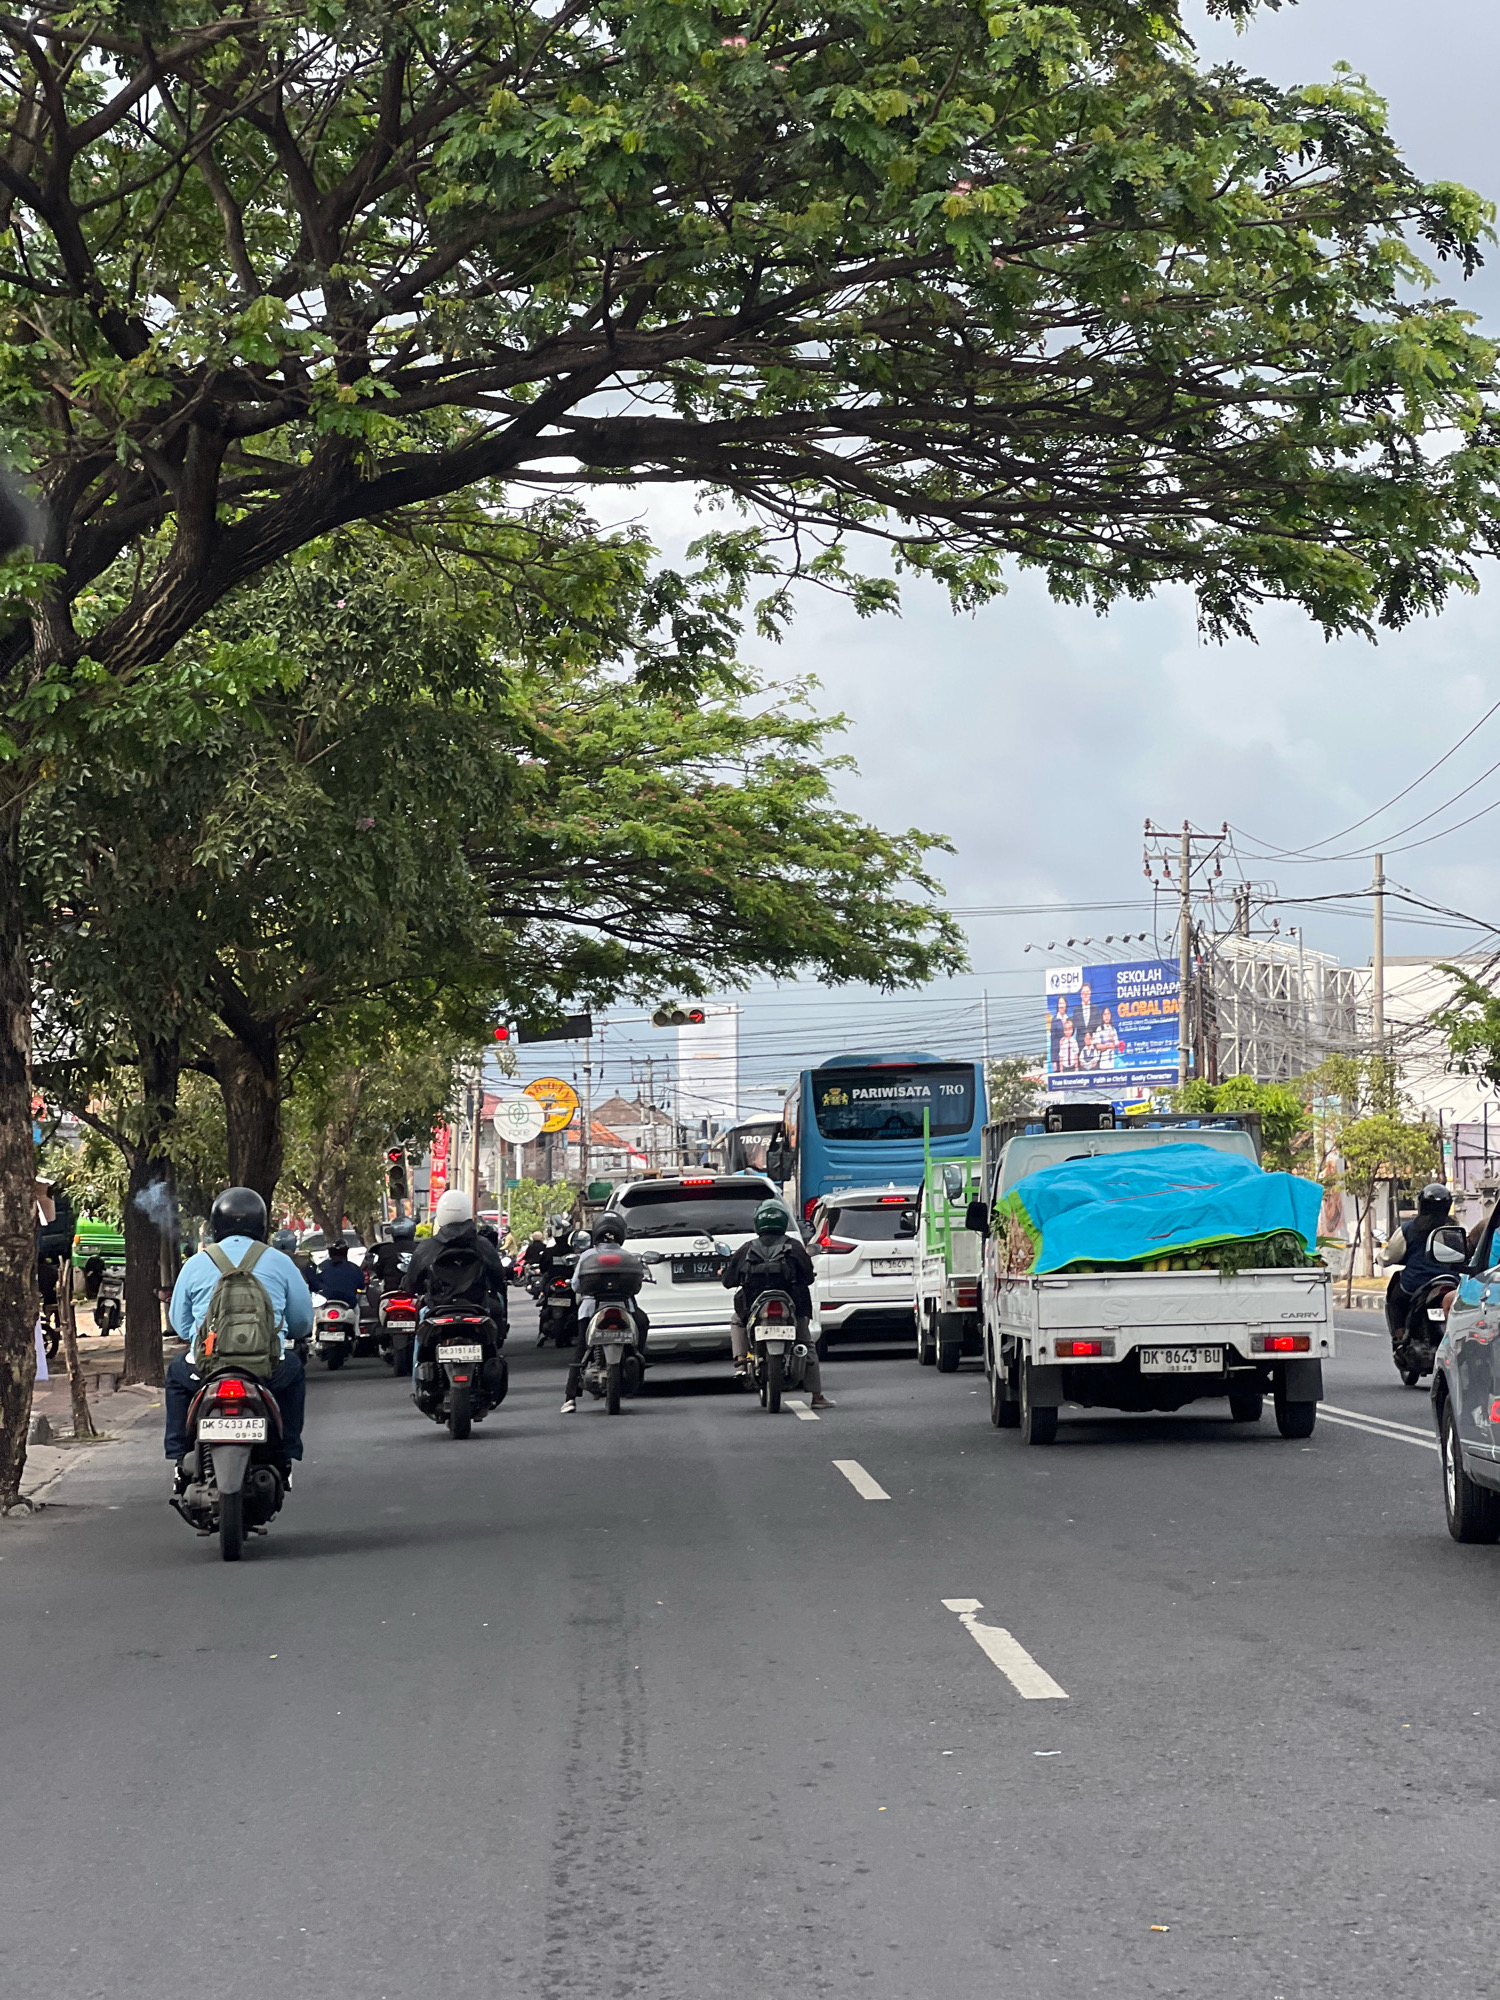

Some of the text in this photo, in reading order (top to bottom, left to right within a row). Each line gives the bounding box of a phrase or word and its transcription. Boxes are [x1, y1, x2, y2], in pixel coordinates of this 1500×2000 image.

[1060, 972, 1080, 985] SDH
[1117, 968, 1162, 985] SEKOLAH
[1117, 985, 1141, 999] DIAN
[1117, 1000, 1162, 1018] GLOBAL
[852, 1084, 965, 1099] PARIWISATA 7RO
[740, 1135, 761, 1145] 7RO
[693, 1261, 714, 1274] 1924
[1280, 1311, 1320, 1319] CARRY
[1143, 1349, 1220, 1365] DK 8643 BU
[202, 1419, 264, 1429] DK 5433 AEJ
